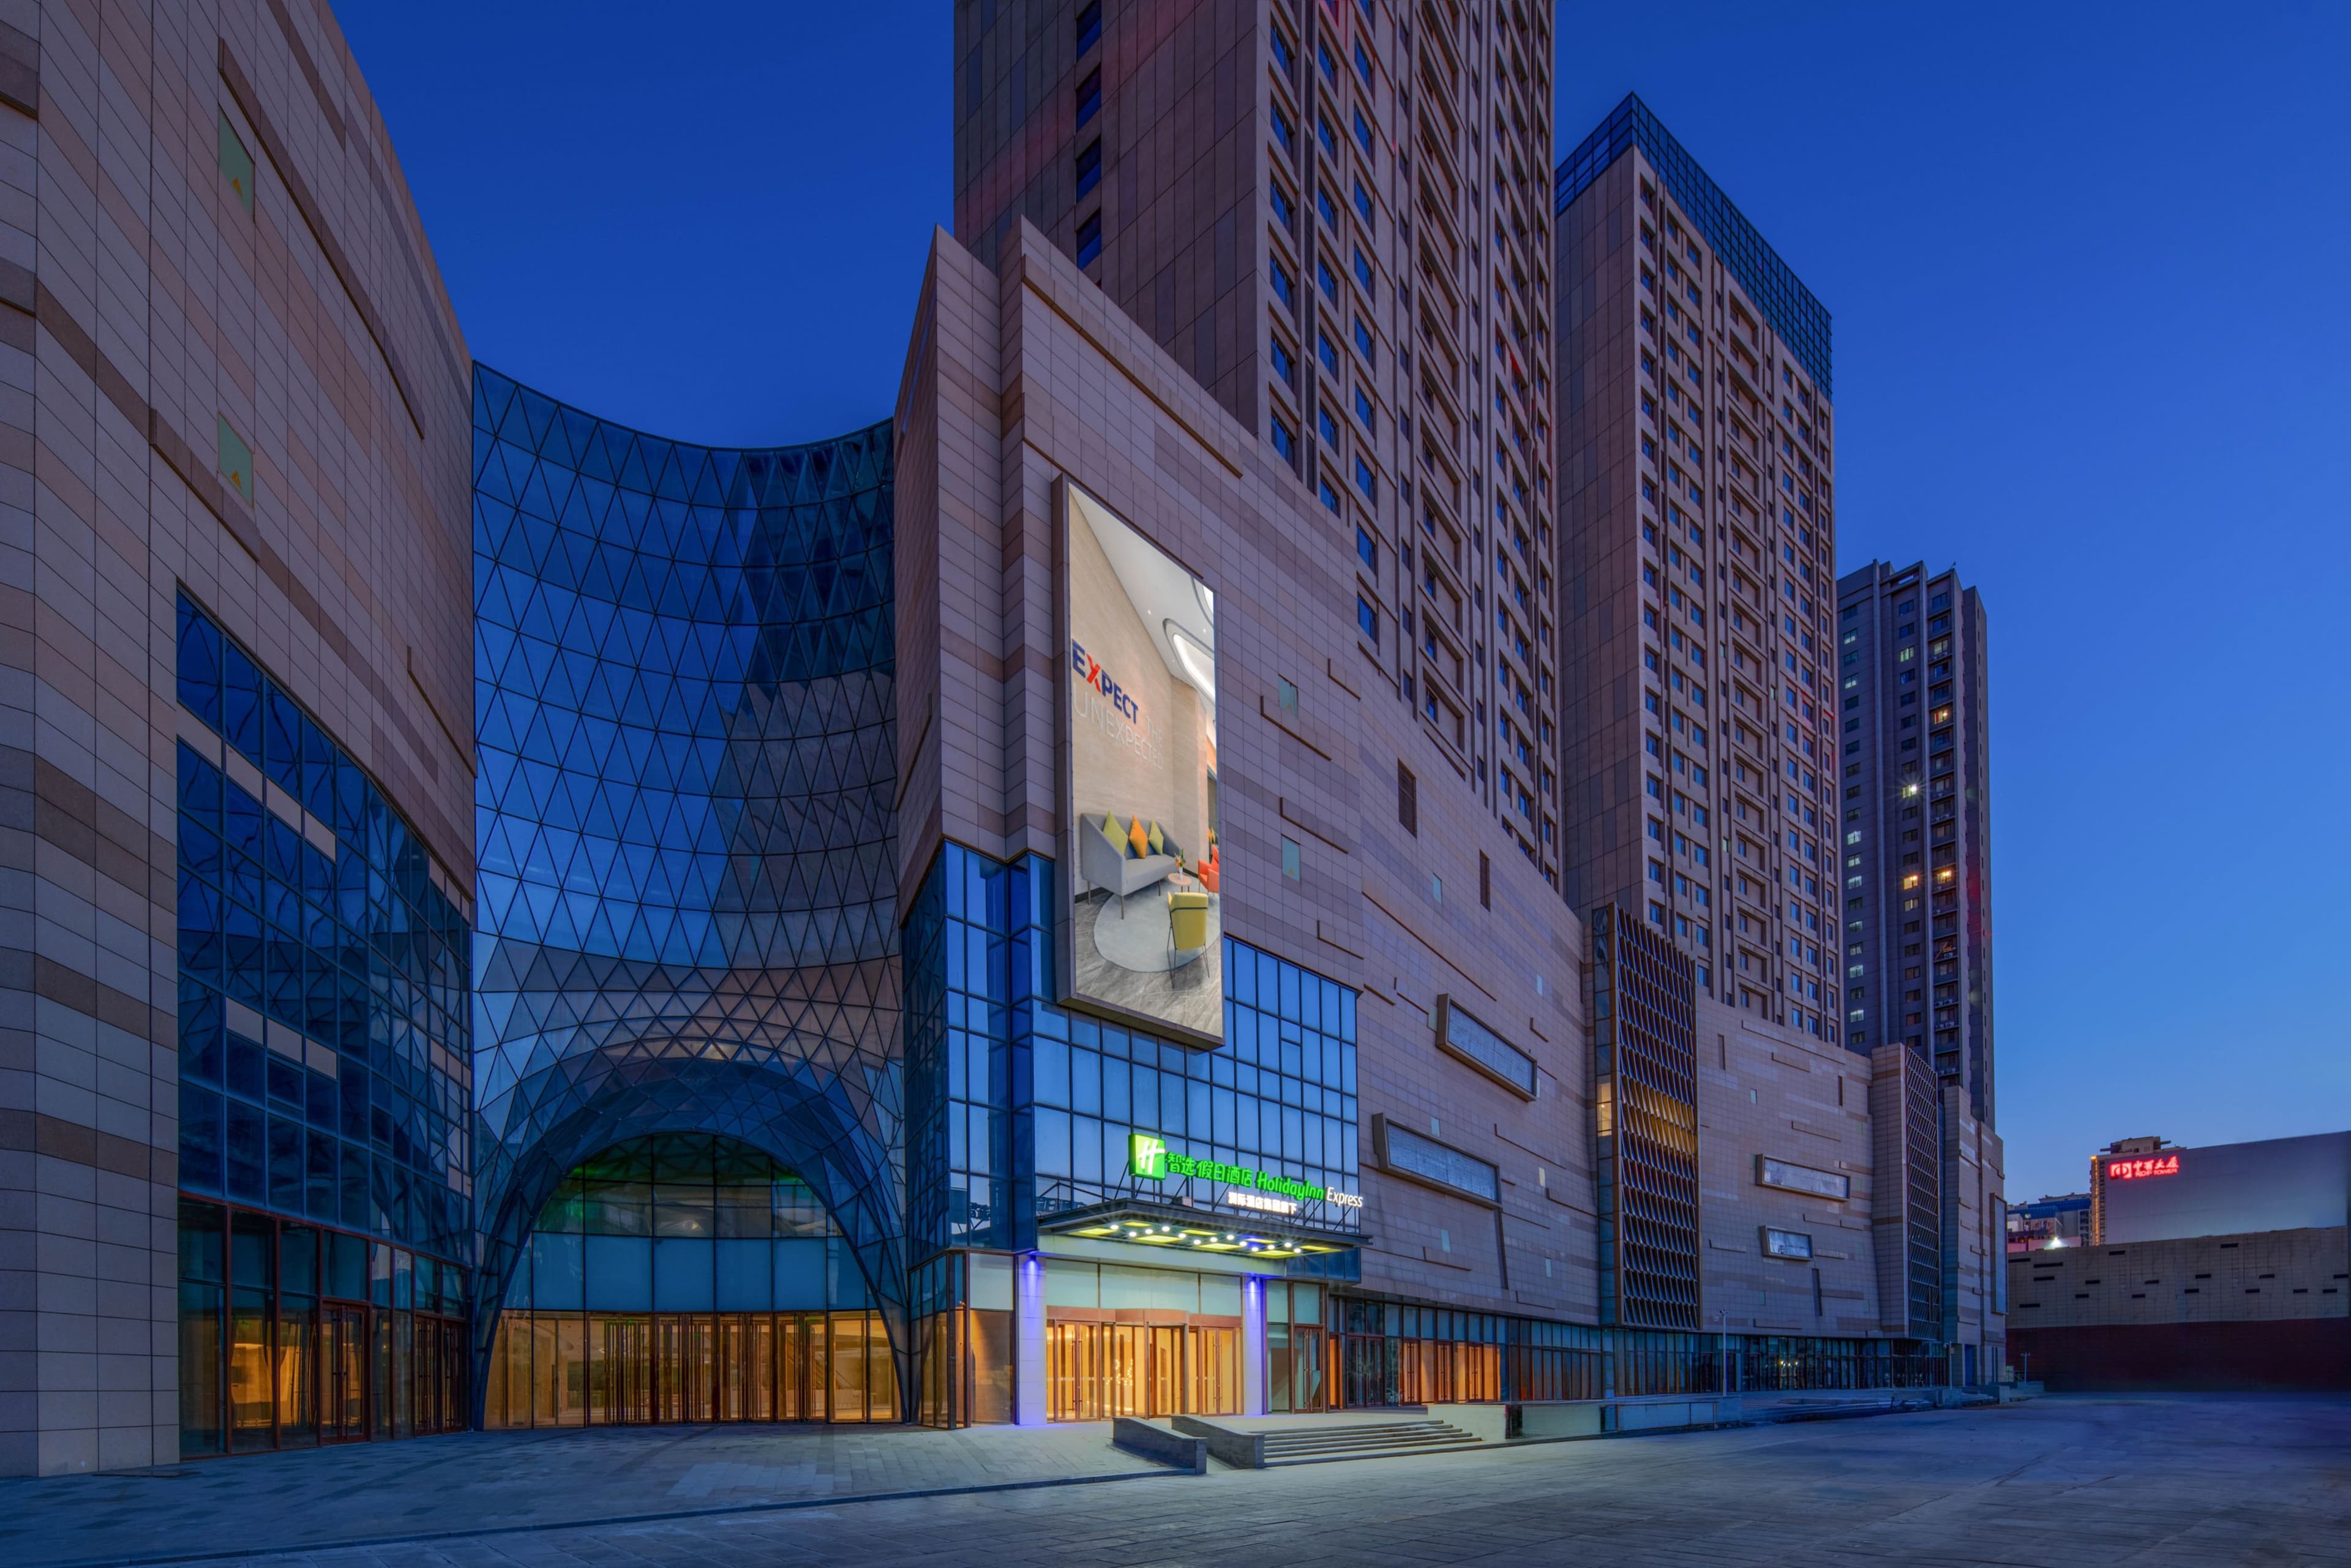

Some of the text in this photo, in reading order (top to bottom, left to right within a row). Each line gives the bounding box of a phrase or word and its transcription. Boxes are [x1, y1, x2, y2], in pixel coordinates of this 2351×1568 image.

[1072, 638, 1163, 748] EXPECT THE
[1073, 681, 1163, 770] UNEXPECTED
[1166, 1151, 1254, 1188] 智选假日酒店
[1325, 1187, 1363, 1208] Express
